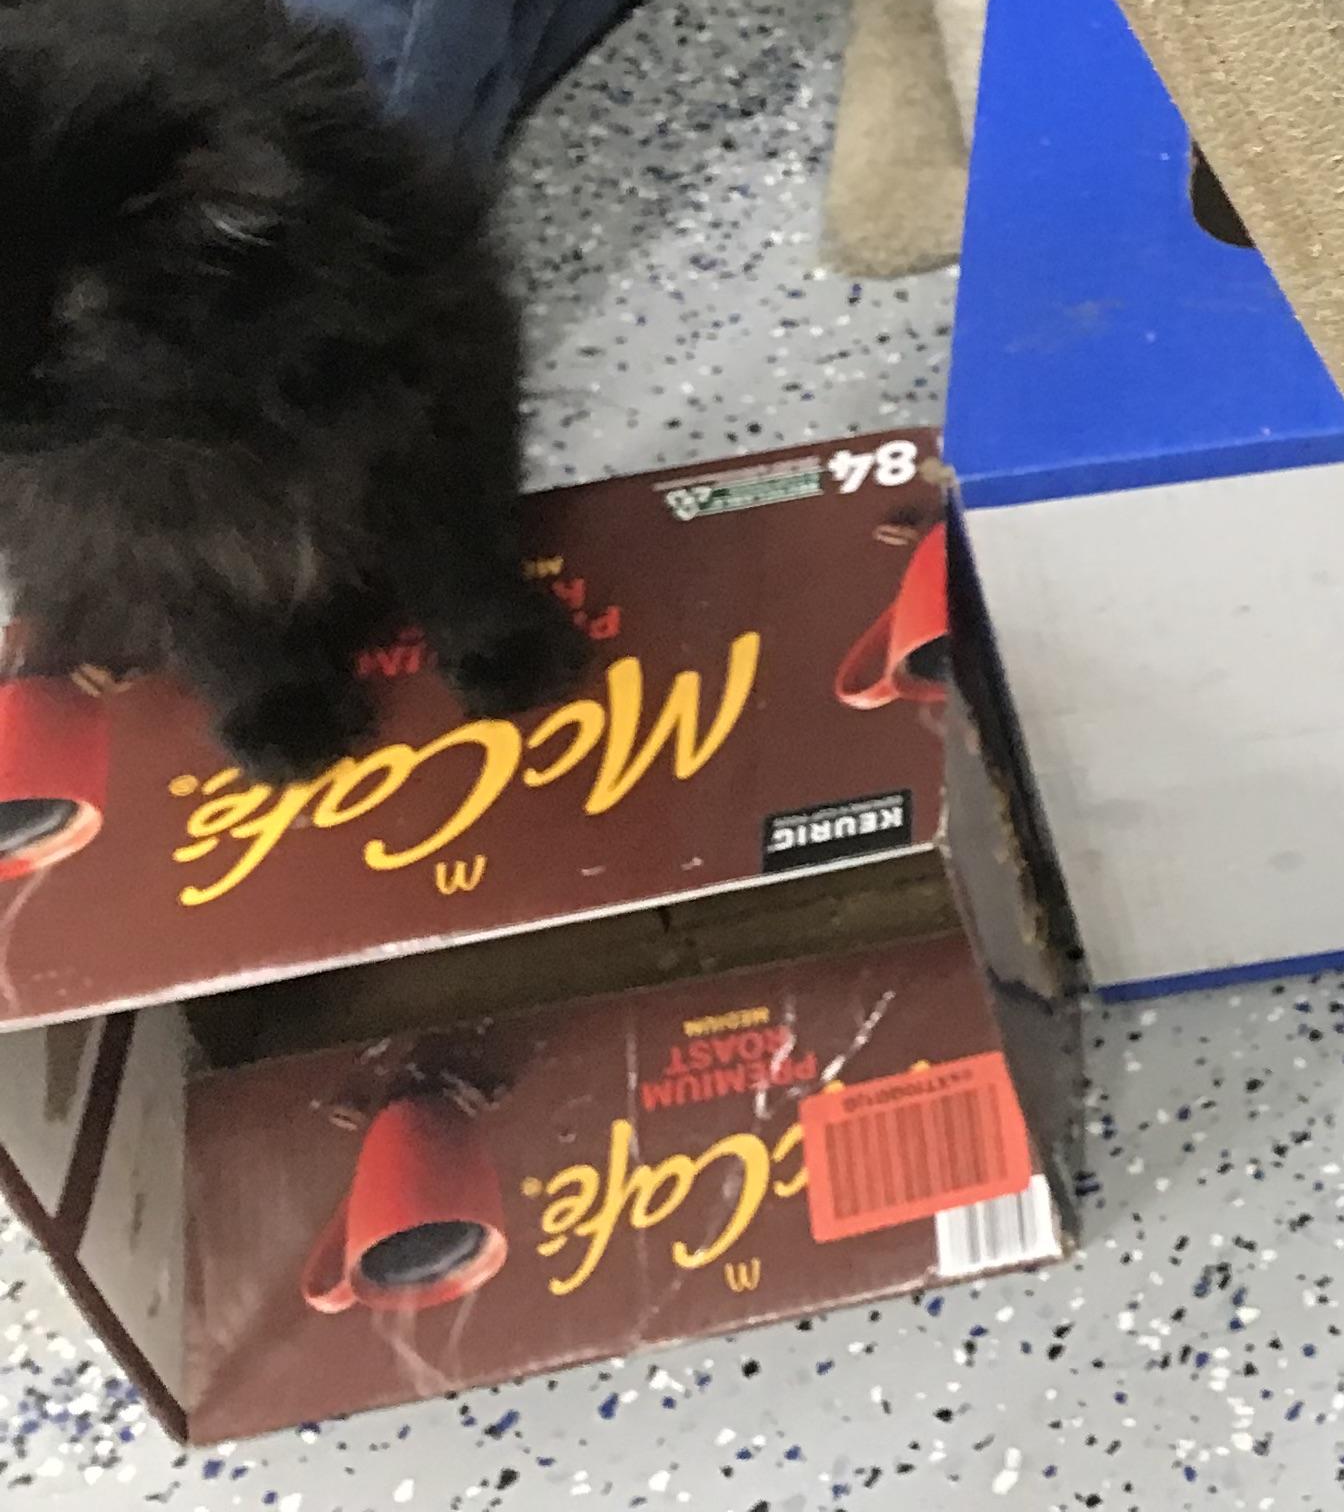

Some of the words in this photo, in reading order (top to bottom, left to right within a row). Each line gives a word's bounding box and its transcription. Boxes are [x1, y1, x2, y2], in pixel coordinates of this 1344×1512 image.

[828, 440, 917, 494] 84
[766, 805, 904, 855] KEURIG
[665, 1027, 792, 1075] ROAST
[641, 1050, 818, 1111] PREMIUM
[537, 1118, 808, 1296] cCafé
